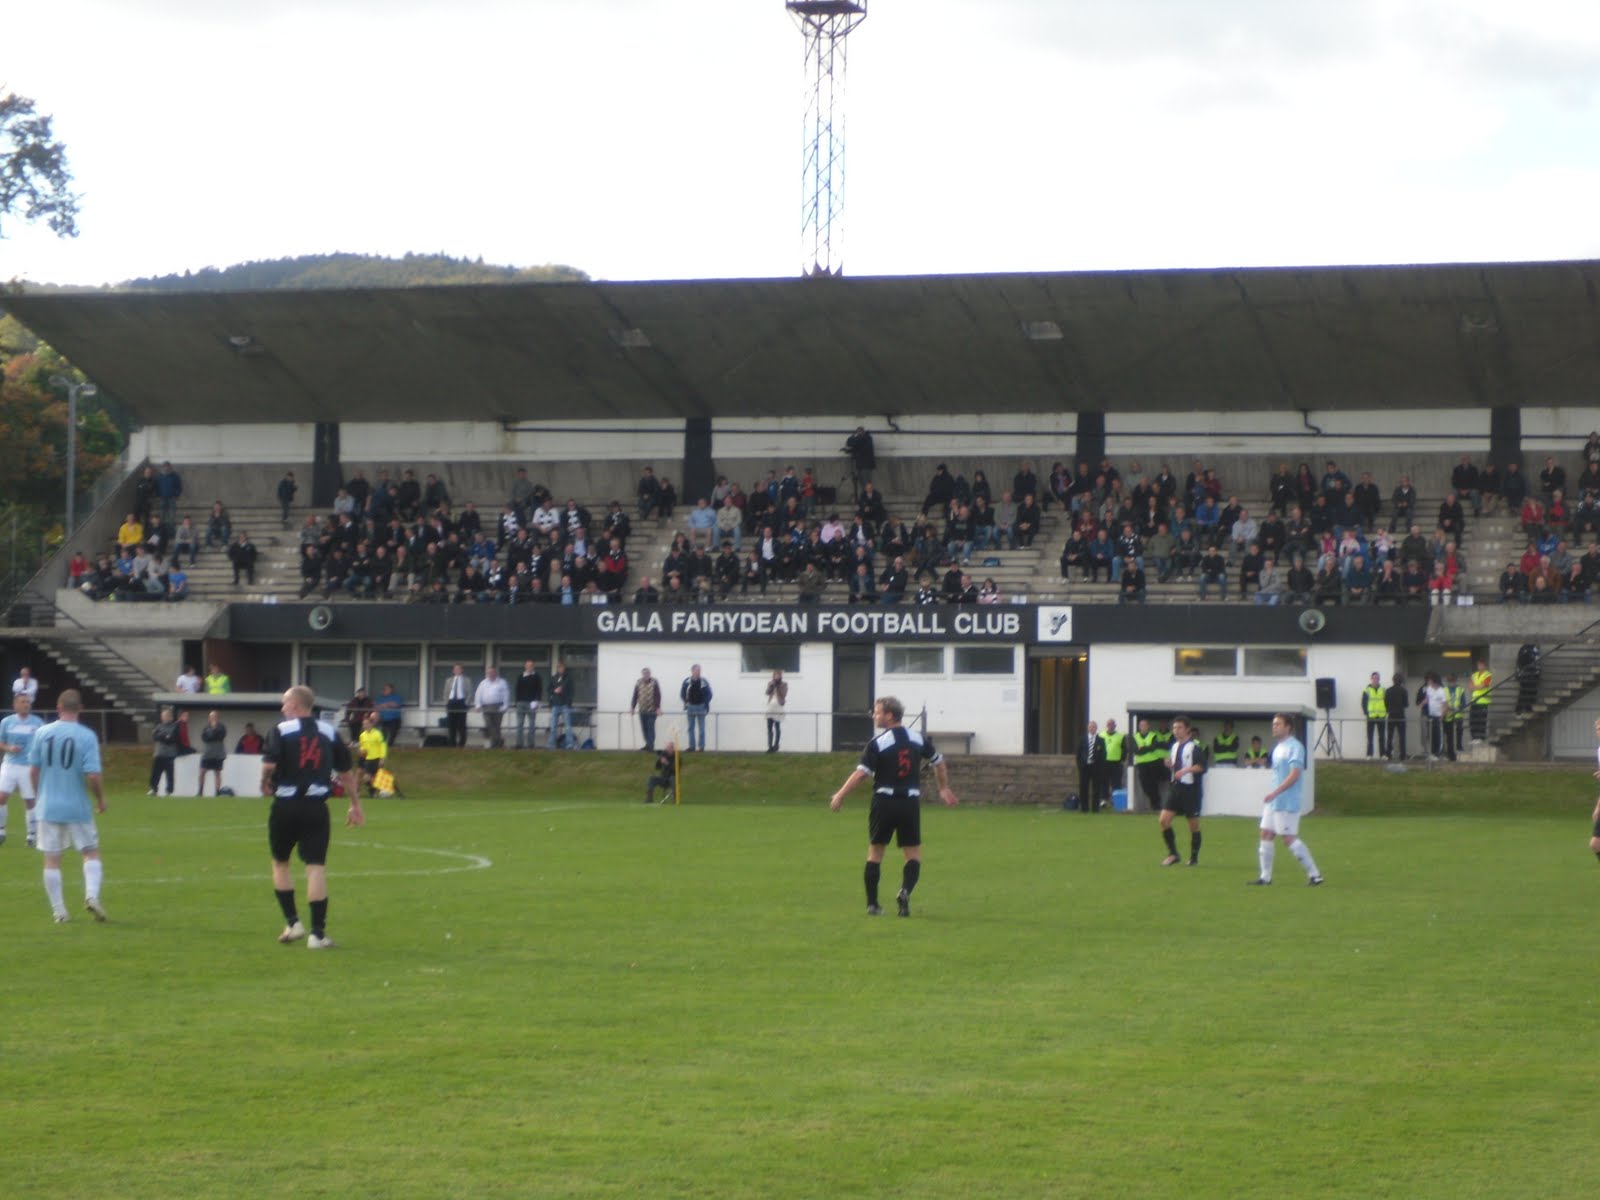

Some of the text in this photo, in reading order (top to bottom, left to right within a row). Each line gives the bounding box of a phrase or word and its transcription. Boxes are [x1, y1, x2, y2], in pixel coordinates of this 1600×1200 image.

[597, 611, 1020, 634] GALA FAIRYDEAN FOOTBALL CLUB
[45, 735, 75, 770] 10
[299, 735, 321, 769] 14
[897, 747, 912, 778] 5
